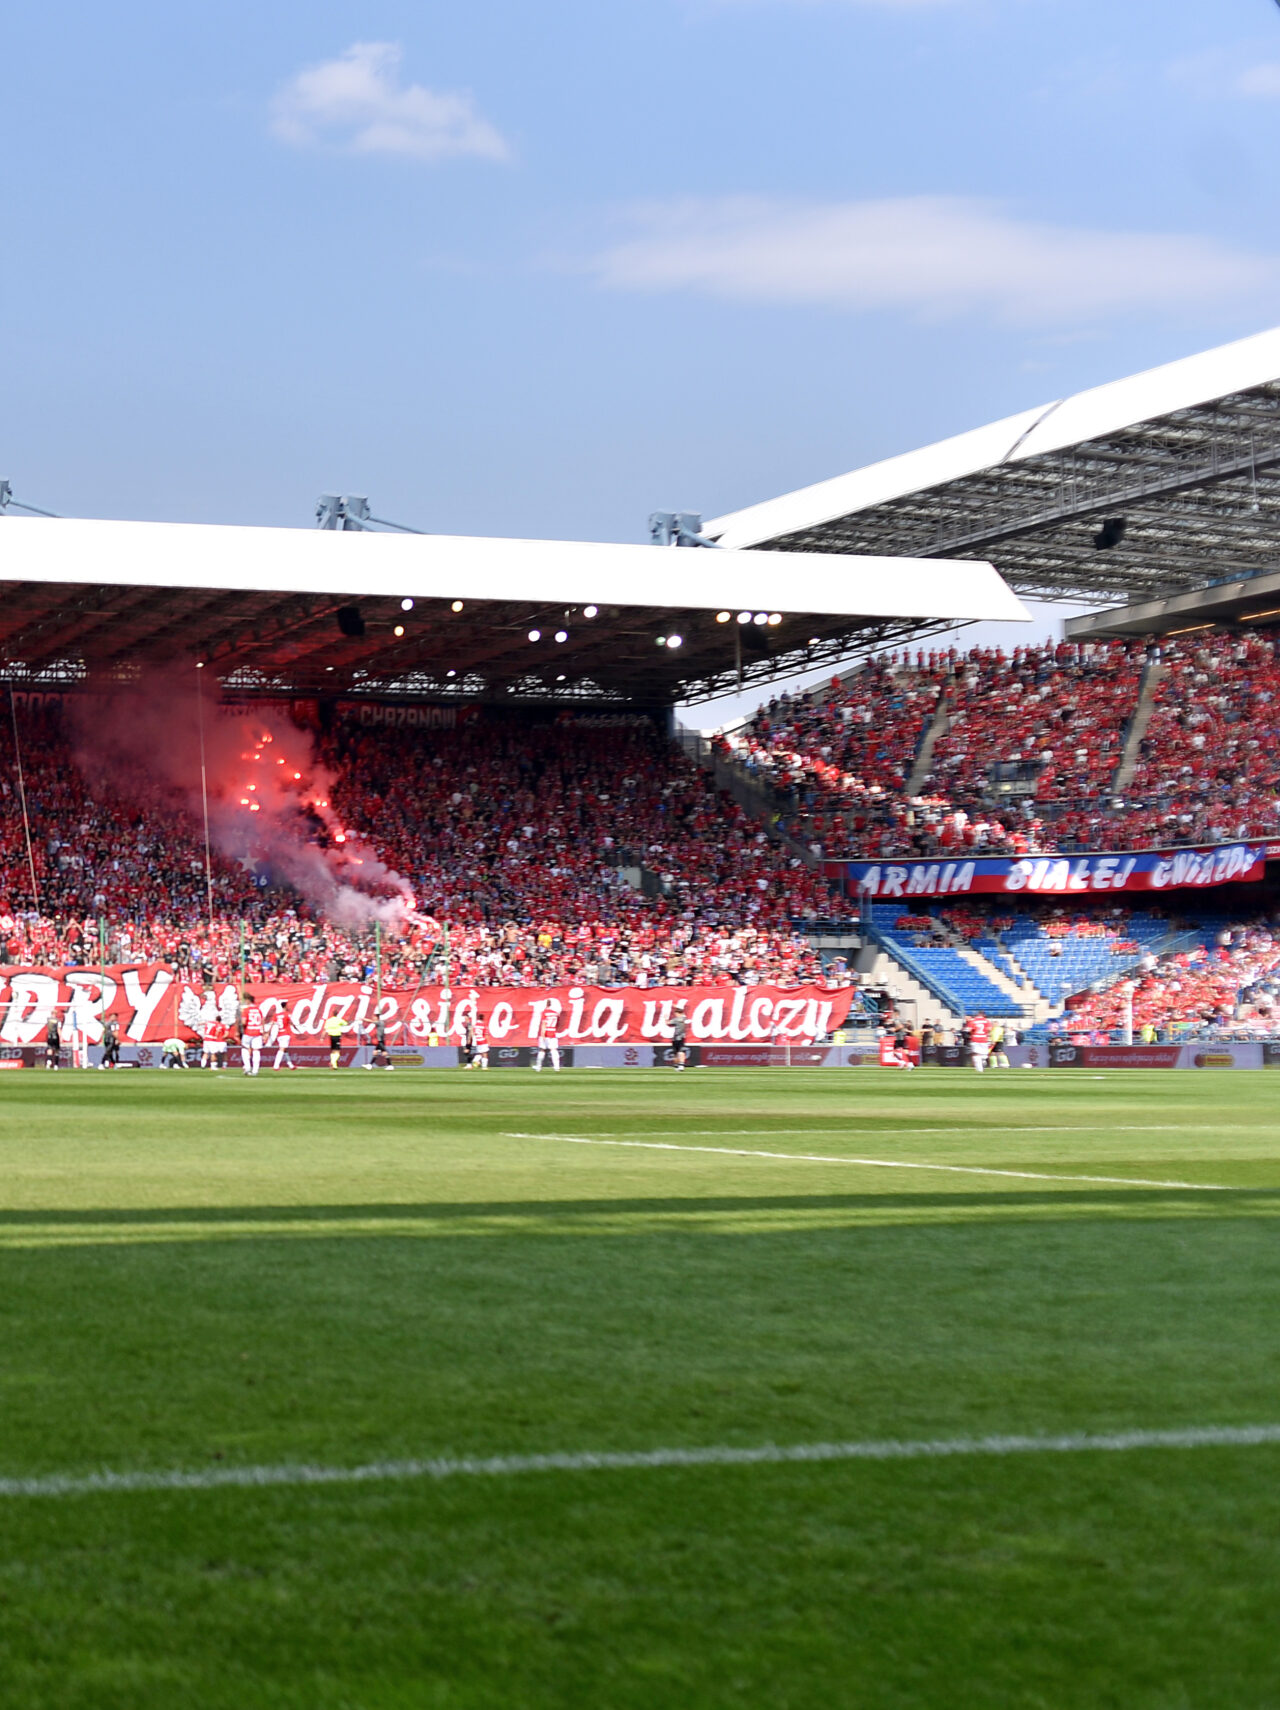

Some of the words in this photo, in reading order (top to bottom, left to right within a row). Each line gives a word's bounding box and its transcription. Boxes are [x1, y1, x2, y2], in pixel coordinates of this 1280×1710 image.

[859, 862, 976, 897] ARMIA
[1006, 857, 1136, 891] BIAŁEJ
[488, 1001, 519, 1038] o
